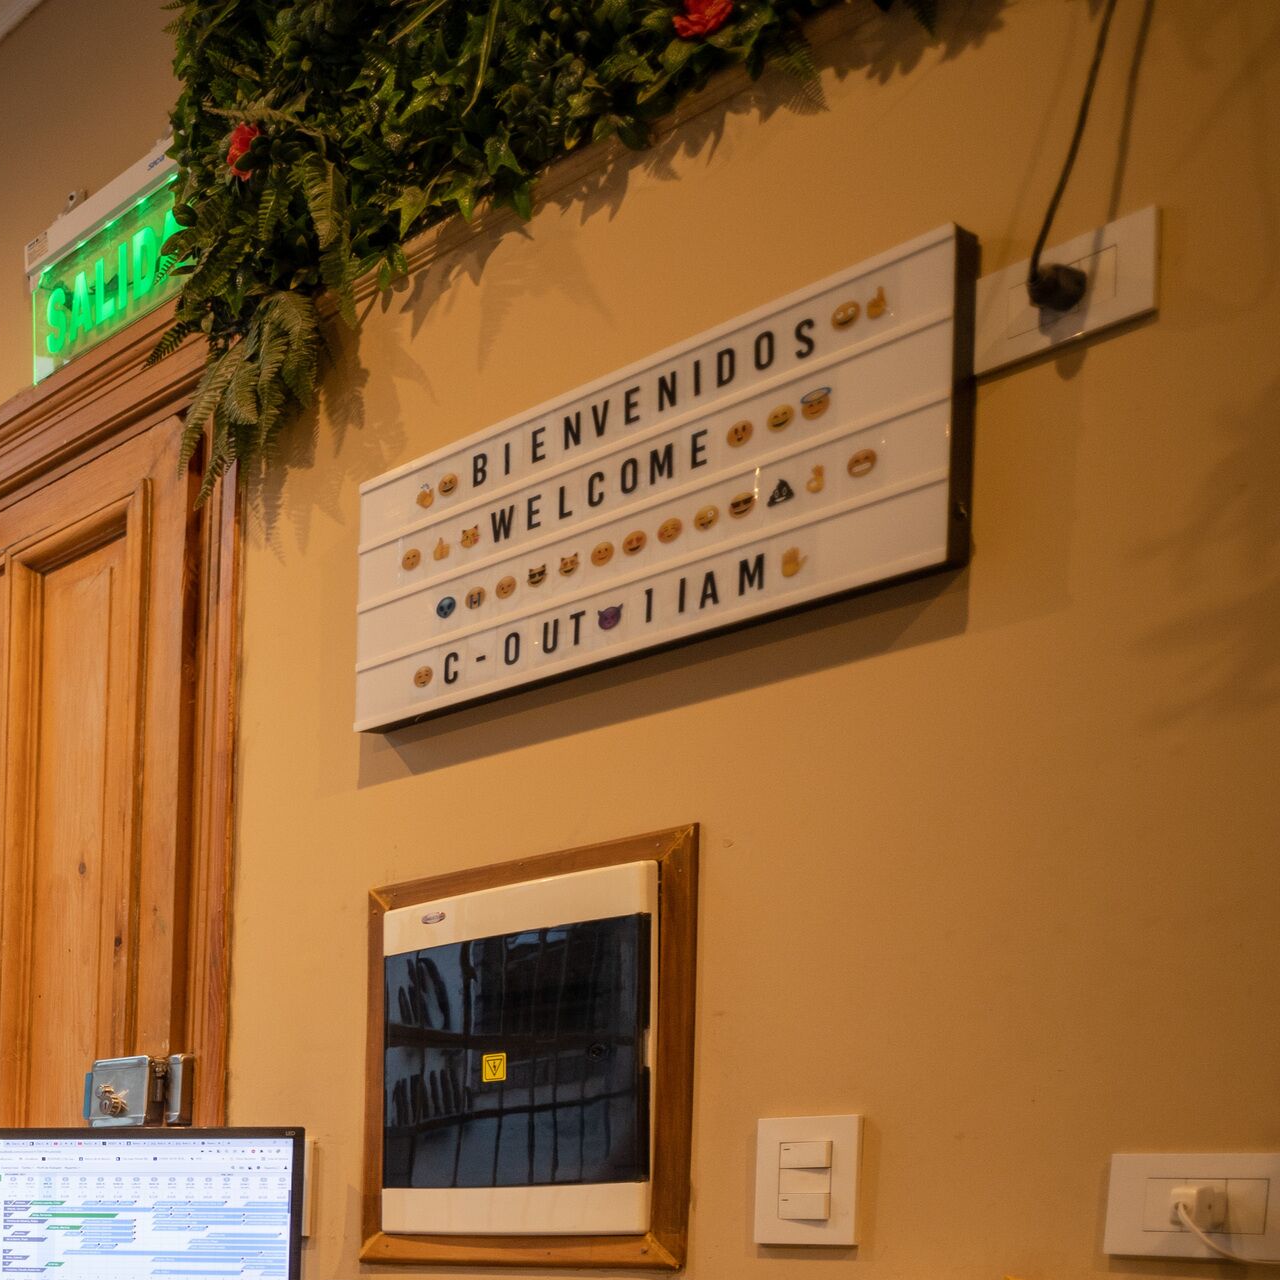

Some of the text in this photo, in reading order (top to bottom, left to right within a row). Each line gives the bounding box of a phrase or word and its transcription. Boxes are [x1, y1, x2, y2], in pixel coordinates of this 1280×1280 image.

[472, 317, 816, 488] BIENVENIDOS
[490, 430, 708, 544] WELCOME
[443, 610, 587, 685] C-OUT
